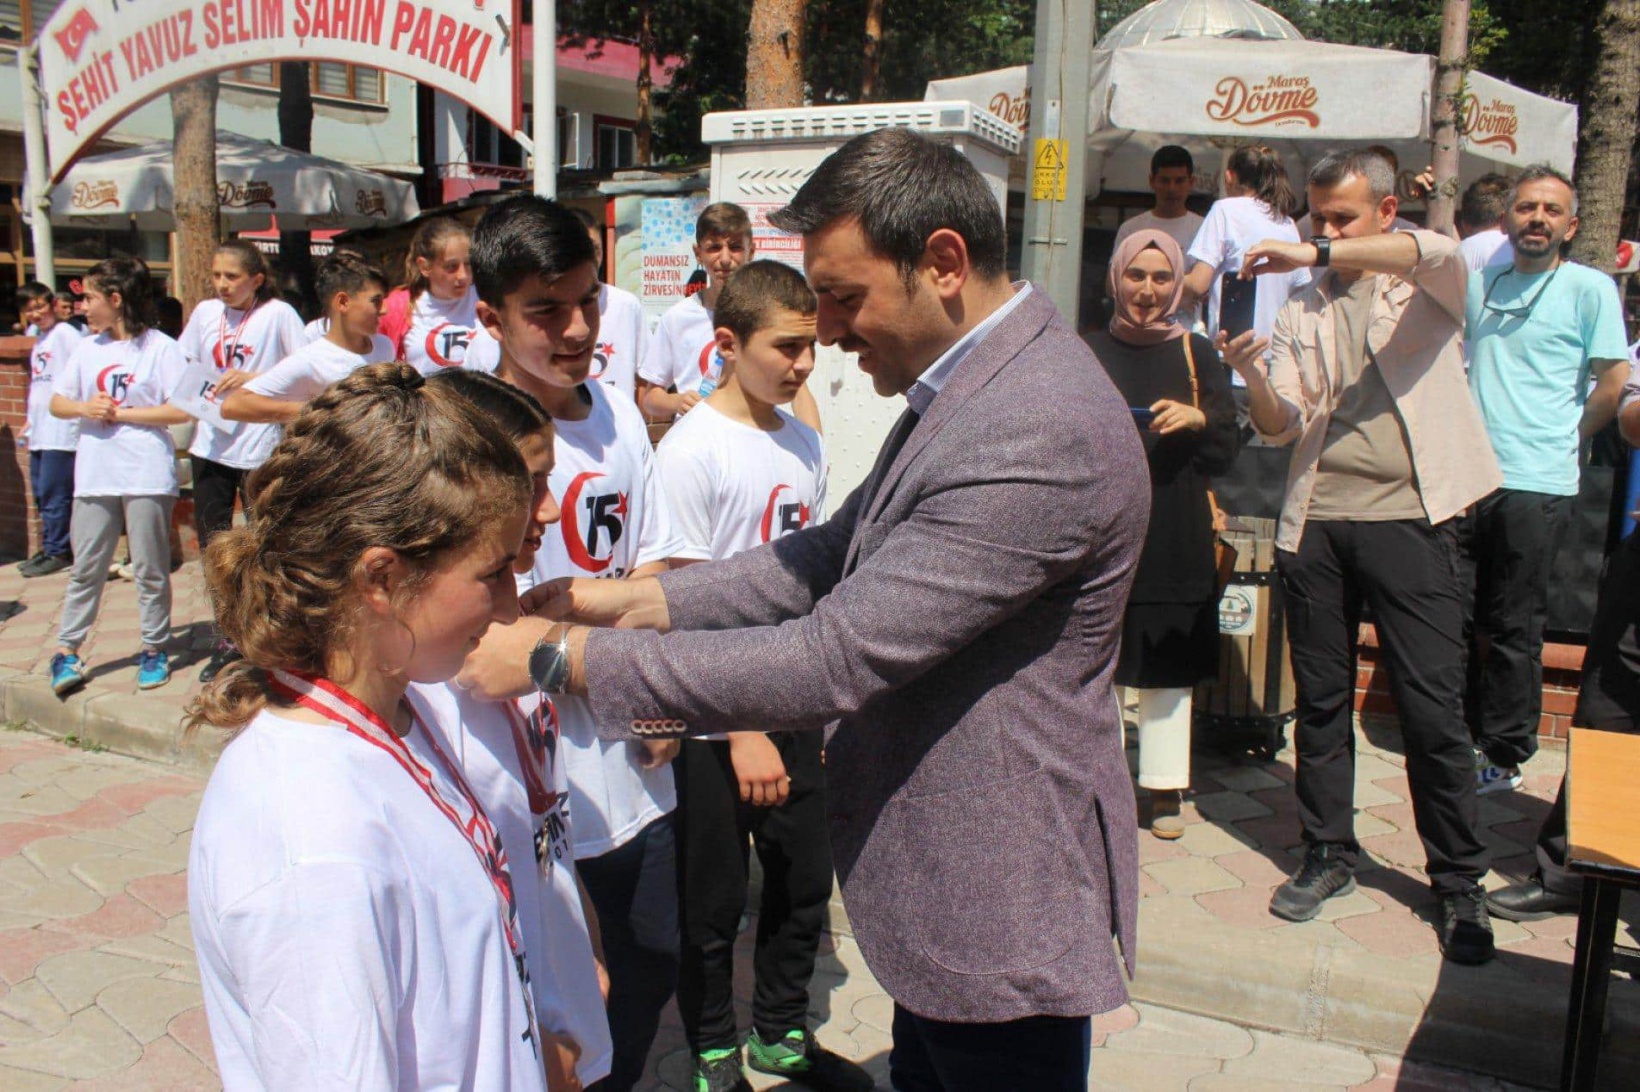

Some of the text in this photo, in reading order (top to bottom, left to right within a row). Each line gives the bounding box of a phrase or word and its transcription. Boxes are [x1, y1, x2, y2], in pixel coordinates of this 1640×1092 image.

[56, 50, 120, 134] ŞEHİT
[119, 9, 198, 82] YAVUZ
[1206, 76, 1318, 120] Dövme
[643, 254, 690, 267] DUMANSIZ
[643, 270, 681, 282] HAYATIN
[225, 344, 245, 368] 15
[443, 331, 470, 361] 15
[111, 373, 130, 399] 15
[585, 493, 623, 558] 15
